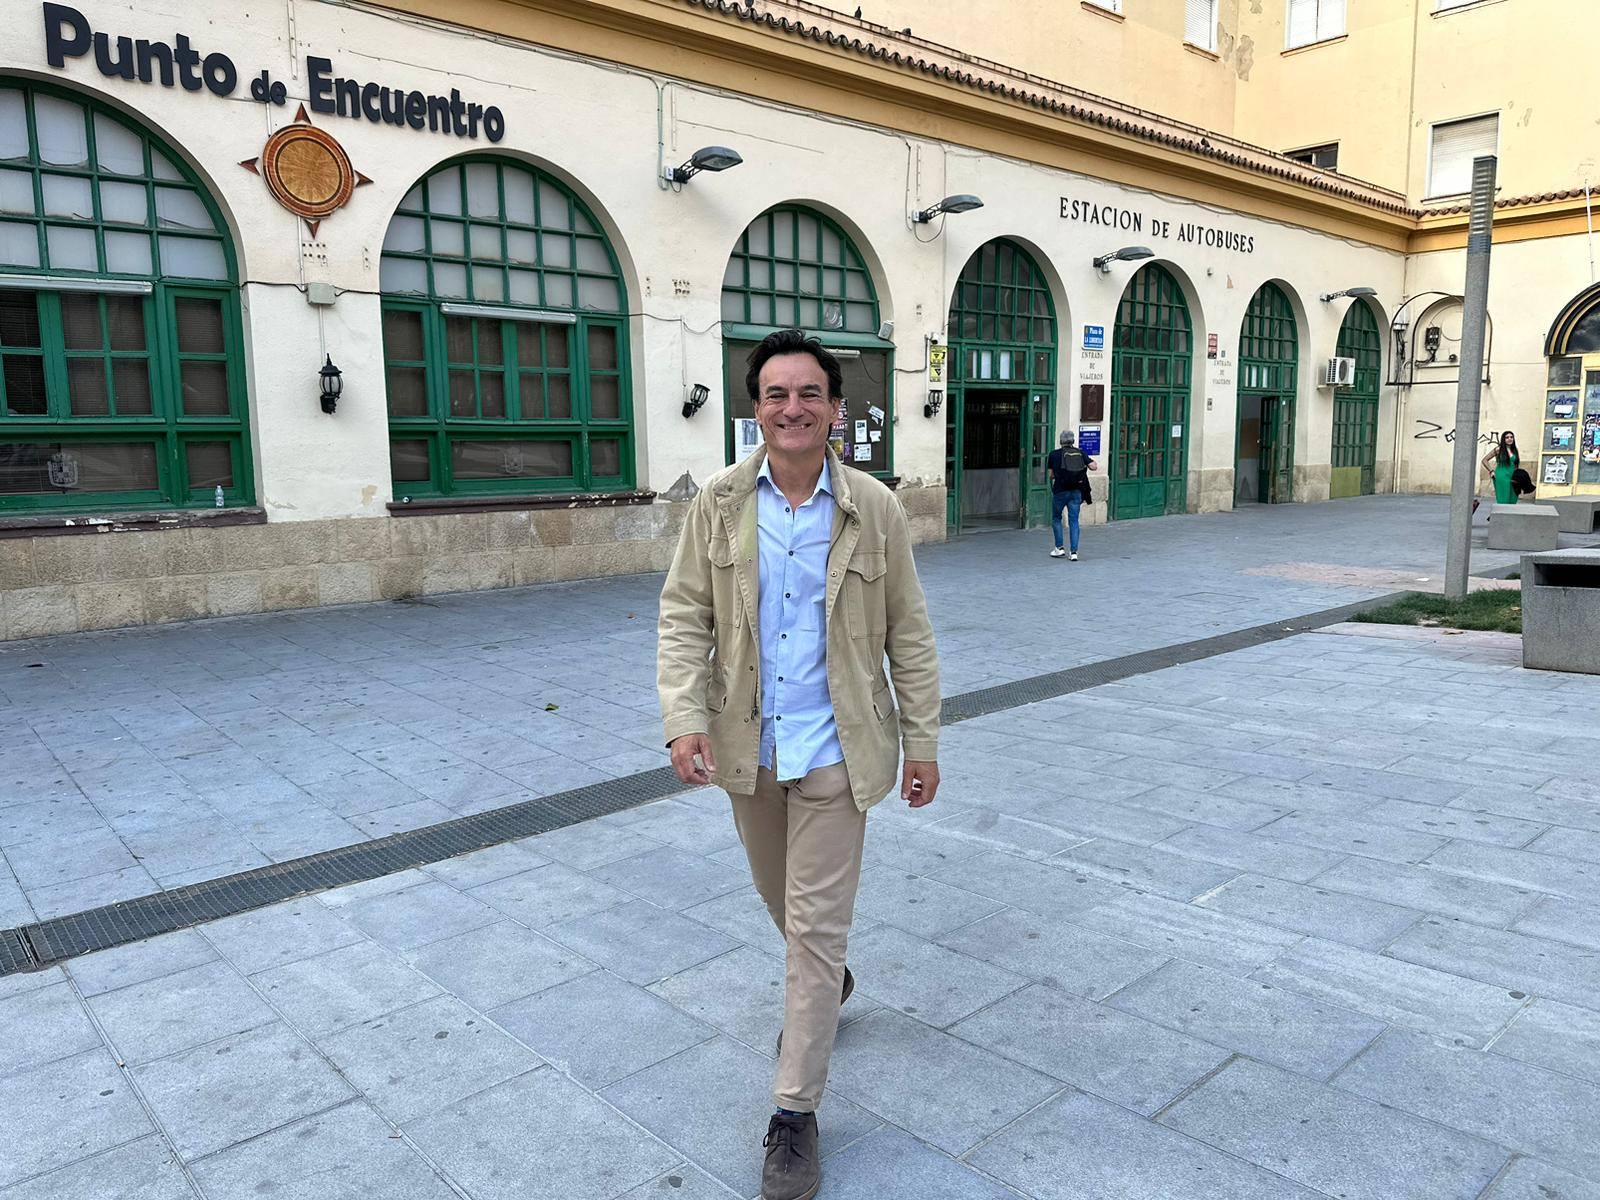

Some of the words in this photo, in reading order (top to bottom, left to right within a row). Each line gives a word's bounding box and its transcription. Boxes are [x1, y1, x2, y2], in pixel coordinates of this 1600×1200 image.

[43, 2, 238, 97] Punto
[251, 70, 288, 105] de
[307, 56, 506, 143] Encuentro
[1060, 197, 1142, 232] ESTACION
[1152, 219, 1170, 238] DE
[1177, 223, 1255, 254] AUTOBUSES
[1081, 351, 1104, 359] ENTRADA
